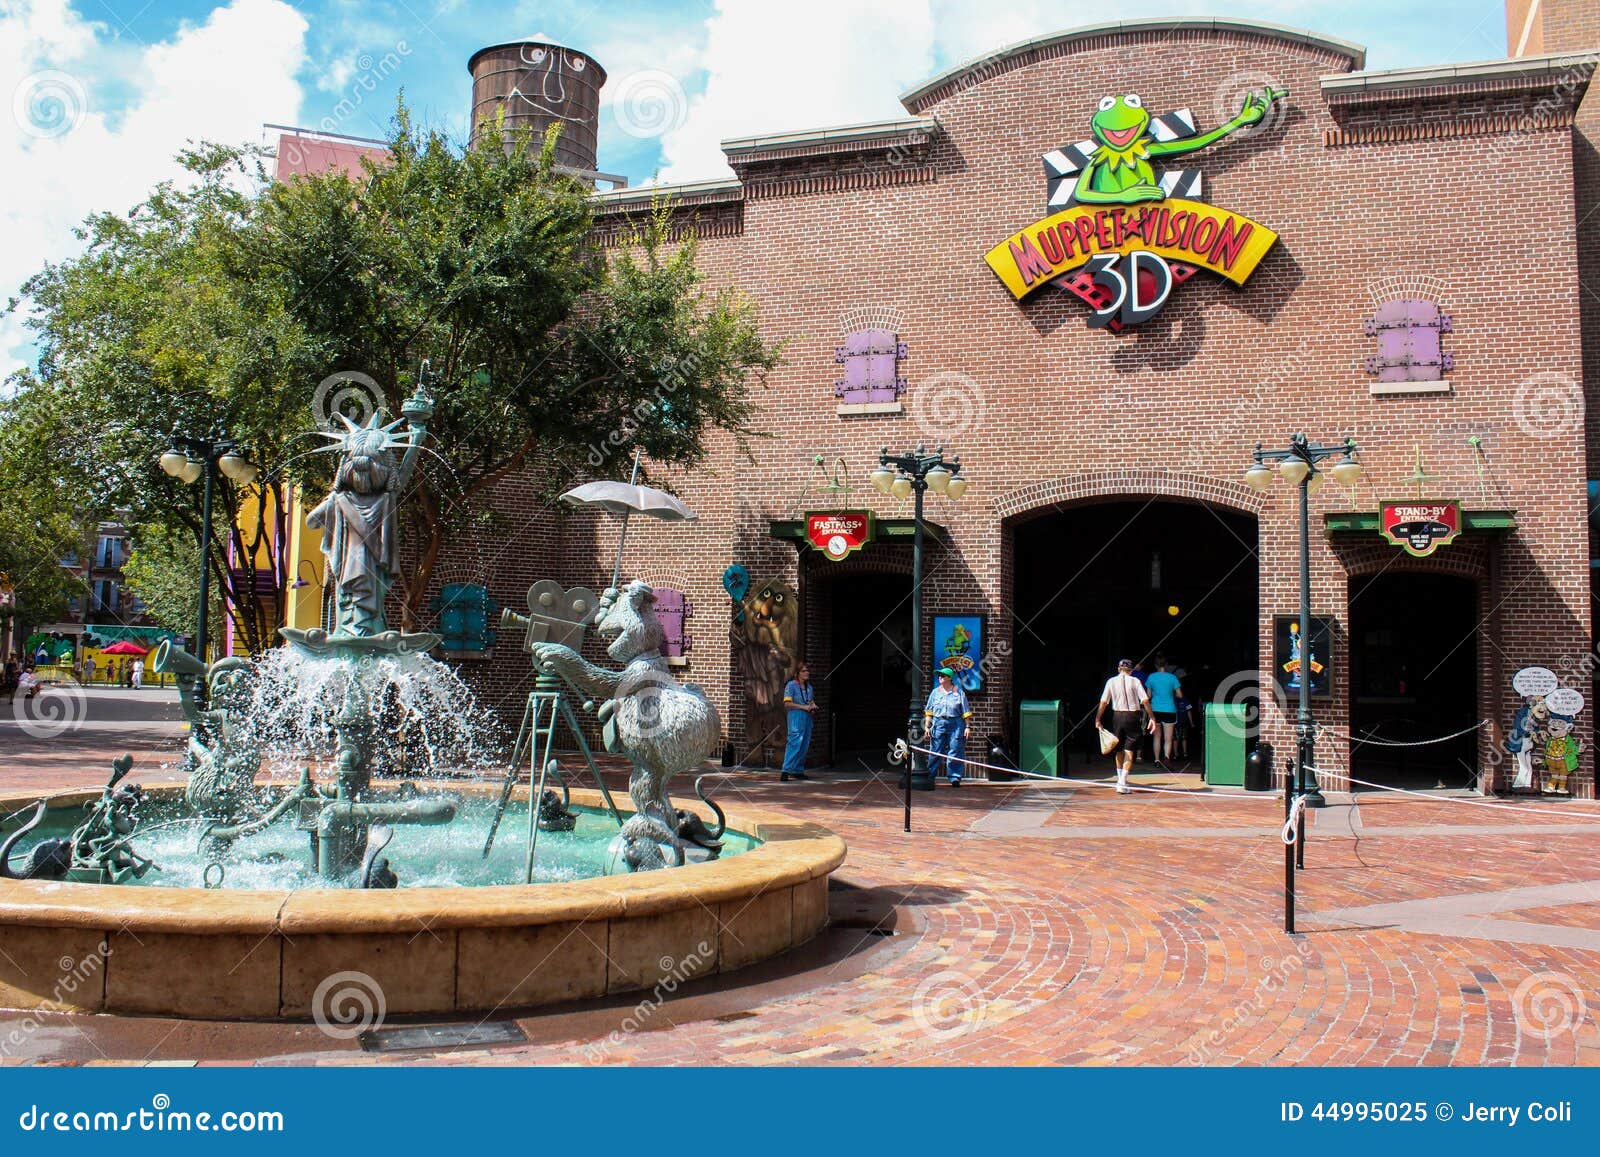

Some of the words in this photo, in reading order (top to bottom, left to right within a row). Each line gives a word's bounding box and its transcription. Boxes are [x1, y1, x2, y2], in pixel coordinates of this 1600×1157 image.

[1091, 250, 1173, 316] 3D
[1394, 506, 1447, 516] STAND-BY
[813, 520, 863, 530] FASTPASS+
